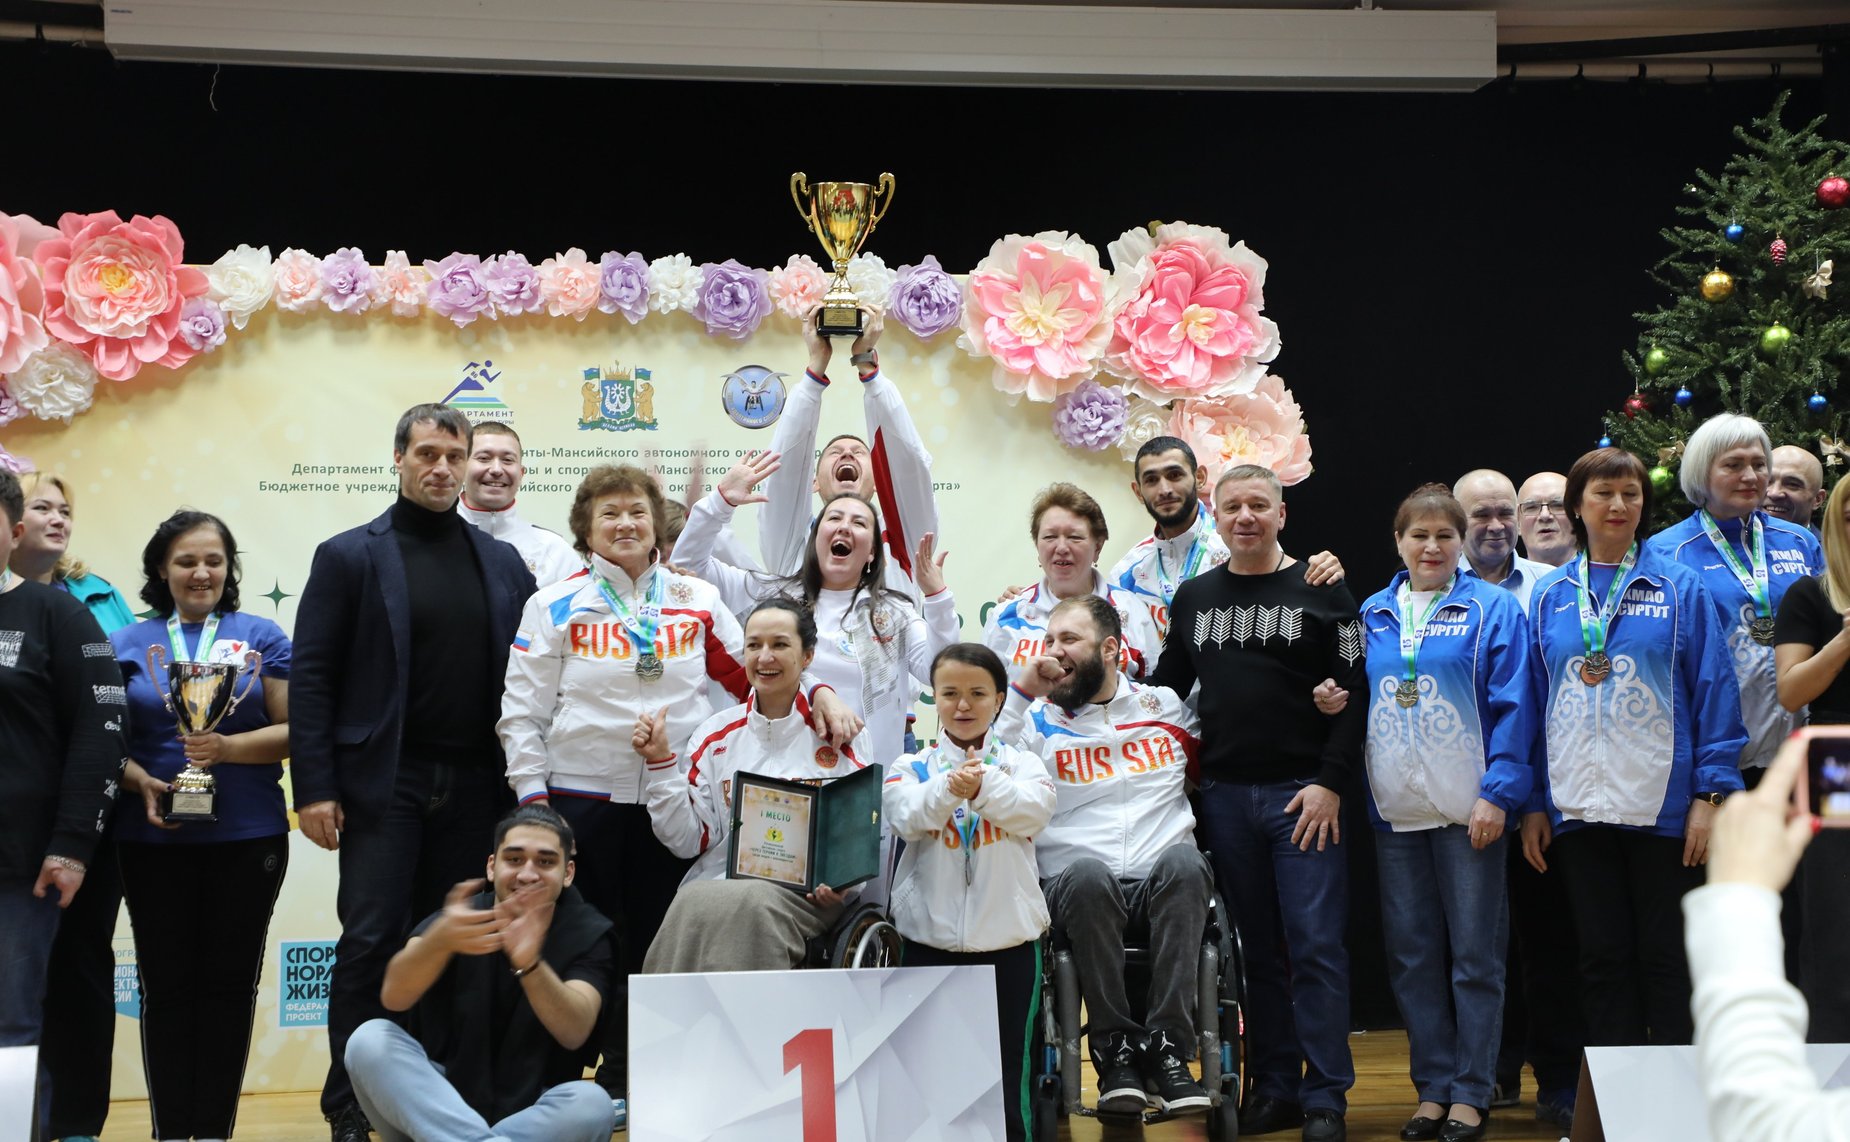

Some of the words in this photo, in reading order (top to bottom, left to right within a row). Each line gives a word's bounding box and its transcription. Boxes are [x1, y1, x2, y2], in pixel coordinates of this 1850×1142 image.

[521, 447, 639, 458] нты-Мансийского
[644, 449, 730, 458] автономного
[292, 463, 384, 476] Департамент
[544, 466, 552, 475] и
[644, 464, 732, 476] -Мансийско
[259, 480, 340, 493] Бюджетное
[345, 483, 399, 494] учрежд
[519, 482, 572, 492] ийского
[932, 482, 961, 491] рта»
[1433, 610, 1468, 623] МАО
[1617, 602, 1670, 619] СУРГУТ
[1424, 624, 1470, 637] СУРГУТ
[286, 946, 336, 964] СПОР
[114, 966, 138, 978] ИОН
[286, 982, 331, 1001] ЖИЗ
[285, 1002, 329, 1011] ФЕДЕРАЛ
[285, 1012, 322, 1022] ПРОЕКТ
[783, 1028, 837, 1142] 1
